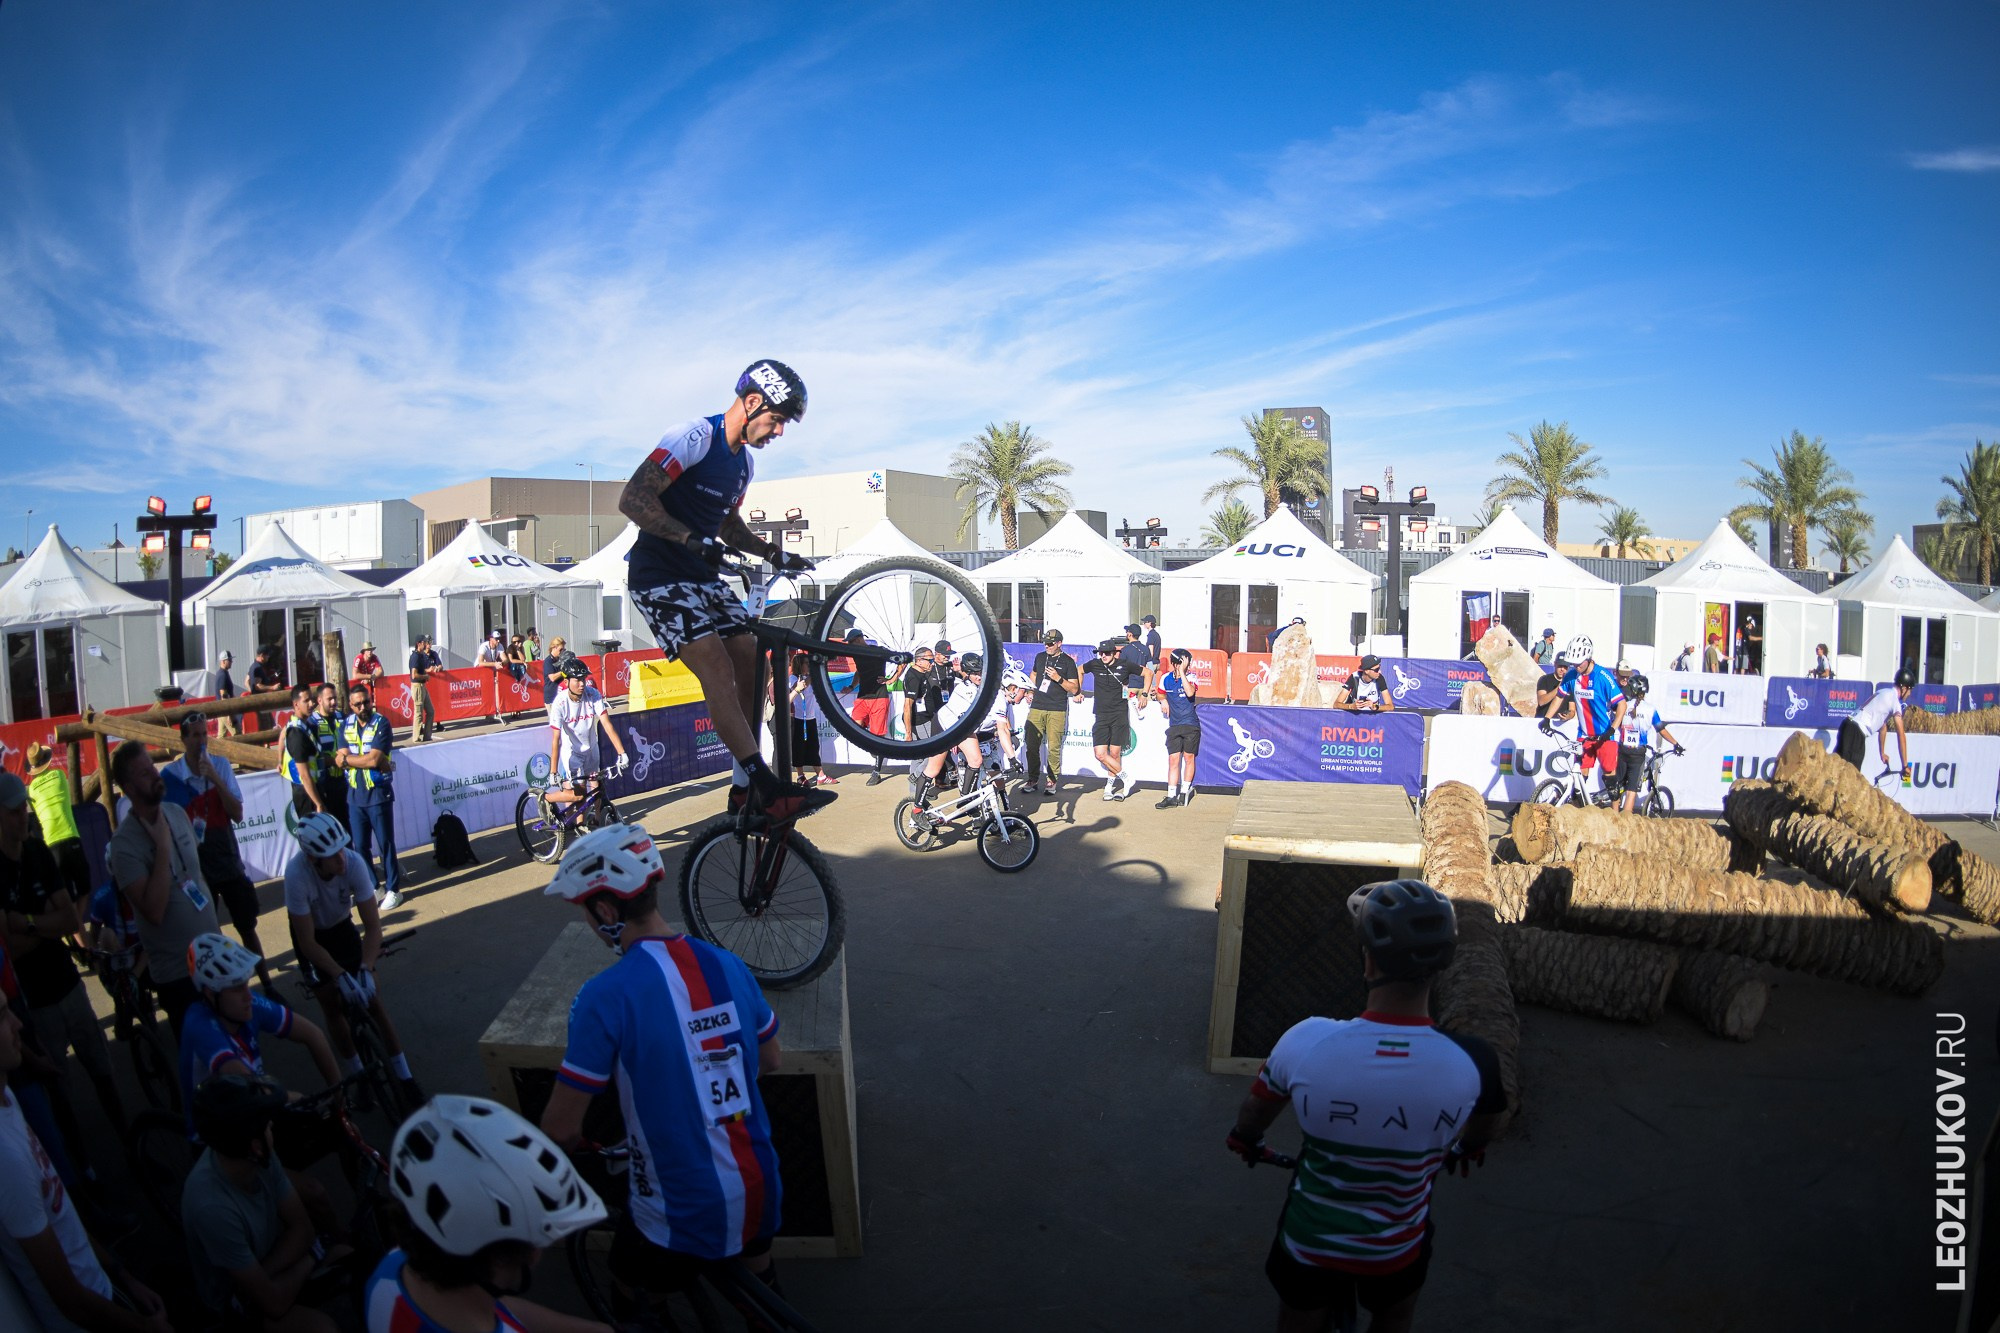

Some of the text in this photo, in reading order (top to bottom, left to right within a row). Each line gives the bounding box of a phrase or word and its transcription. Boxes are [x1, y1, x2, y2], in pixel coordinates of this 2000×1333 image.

[760, 362, 792, 395] TRIAL
[749, 368, 789, 405] BIKES
[1247, 543, 1306, 558] UCI
[480, 554, 531, 568] UCI
[1191, 661, 1212, 669] ADH
[1448, 670, 1485, 681] RIYADH
[450, 680, 481, 691] RIYADH
[1689, 689, 1725, 708] UCI
[1829, 690, 1857, 701] RIYADH
[695, 718, 714, 732] RIY
[696, 732, 718, 746] 2025
[1321, 726, 1384, 743] RIYADH
[697, 748, 730, 760] CHAMPIONSH
[1321, 744, 1383, 758] 2025 UCI
[1320, 765, 1382, 773] CHAMPIONSHIPS
[1515, 748, 1571, 778] UC
[1735, 756, 1777, 780] UC
[1913, 762, 1957, 788] UCI
[433, 794, 456, 805] RIYADH
[456, 789, 479, 800] REGION
[480, 782, 520, 796] MUNICIPALITY
[238, 829, 278, 844] UNICIPALITY
[710, 1077, 741, 1105] 5A
[1303, 1094, 1462, 1131] IRAN
